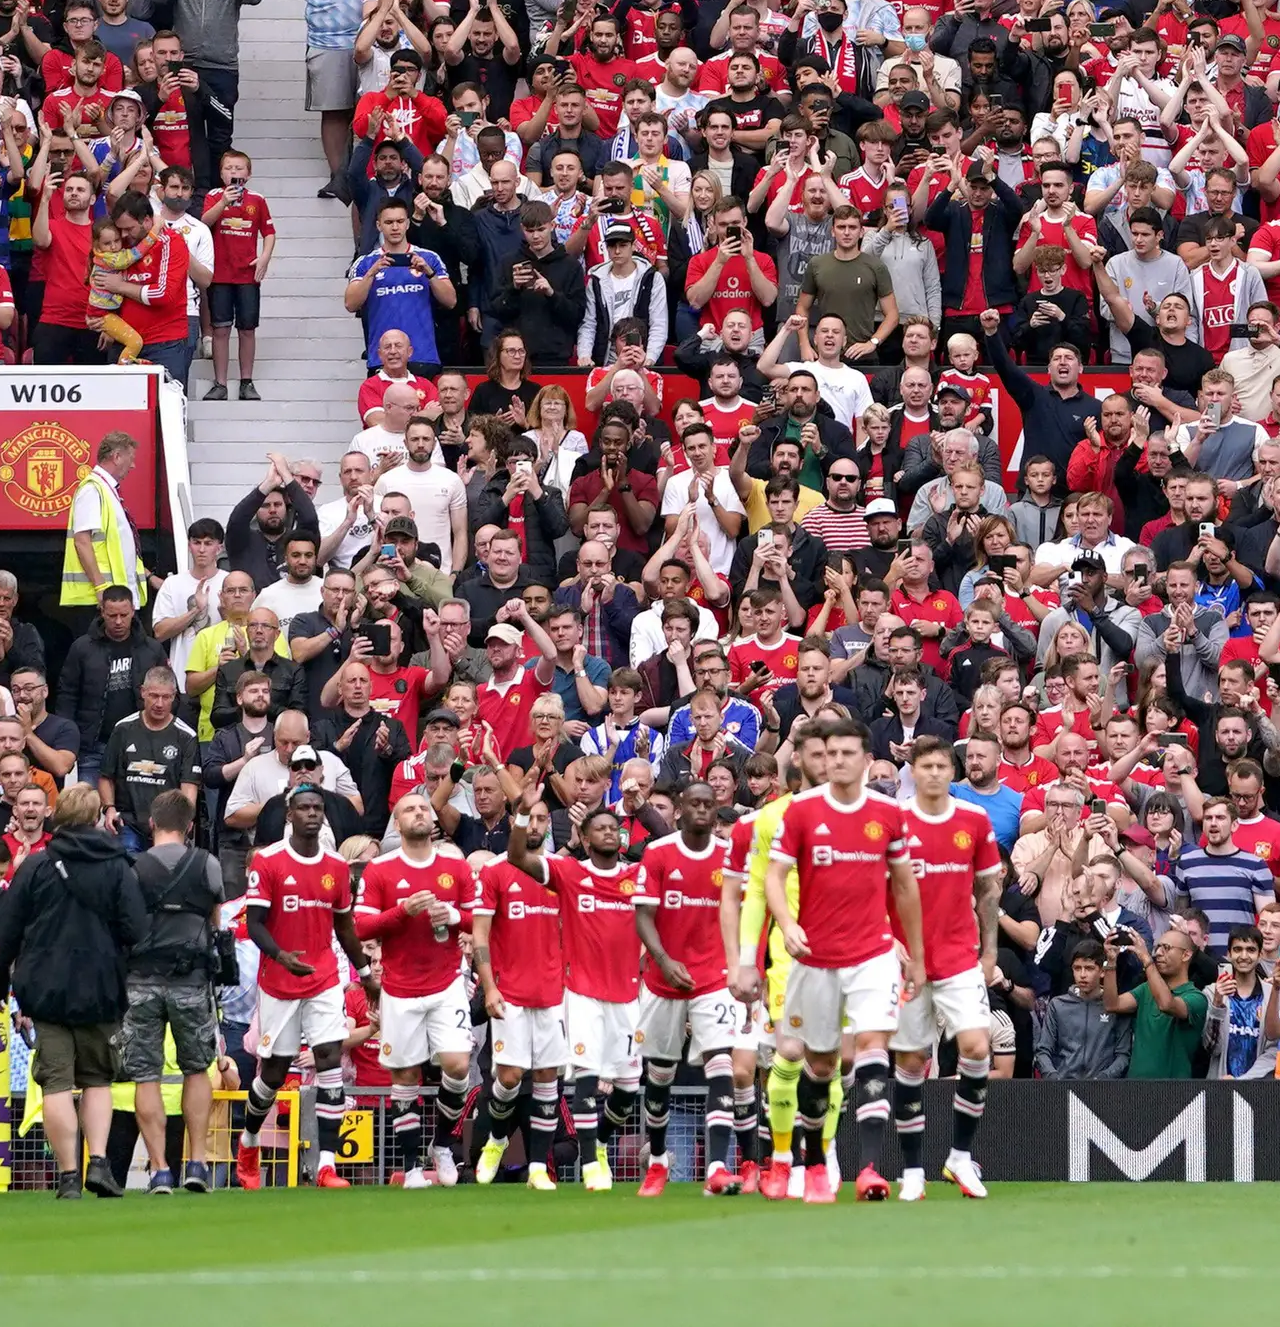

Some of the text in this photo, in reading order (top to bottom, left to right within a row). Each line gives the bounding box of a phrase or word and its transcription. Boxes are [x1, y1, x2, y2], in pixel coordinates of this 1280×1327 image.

[220, 229, 253, 237] CHEVROLET
[129, 271, 152, 282] ARP
[376, 283, 425, 297] SHARP
[11, 383, 82, 404] W106
[5, 424, 88, 461] MANCHESTER
[20, 492, 75, 516] UNITED
[125, 775, 167, 786] CHEVROLET
[832, 851, 882, 863] TeamViewer
[454, 1008, 472, 1030] 2
[337, 1130, 359, 1158] 6
